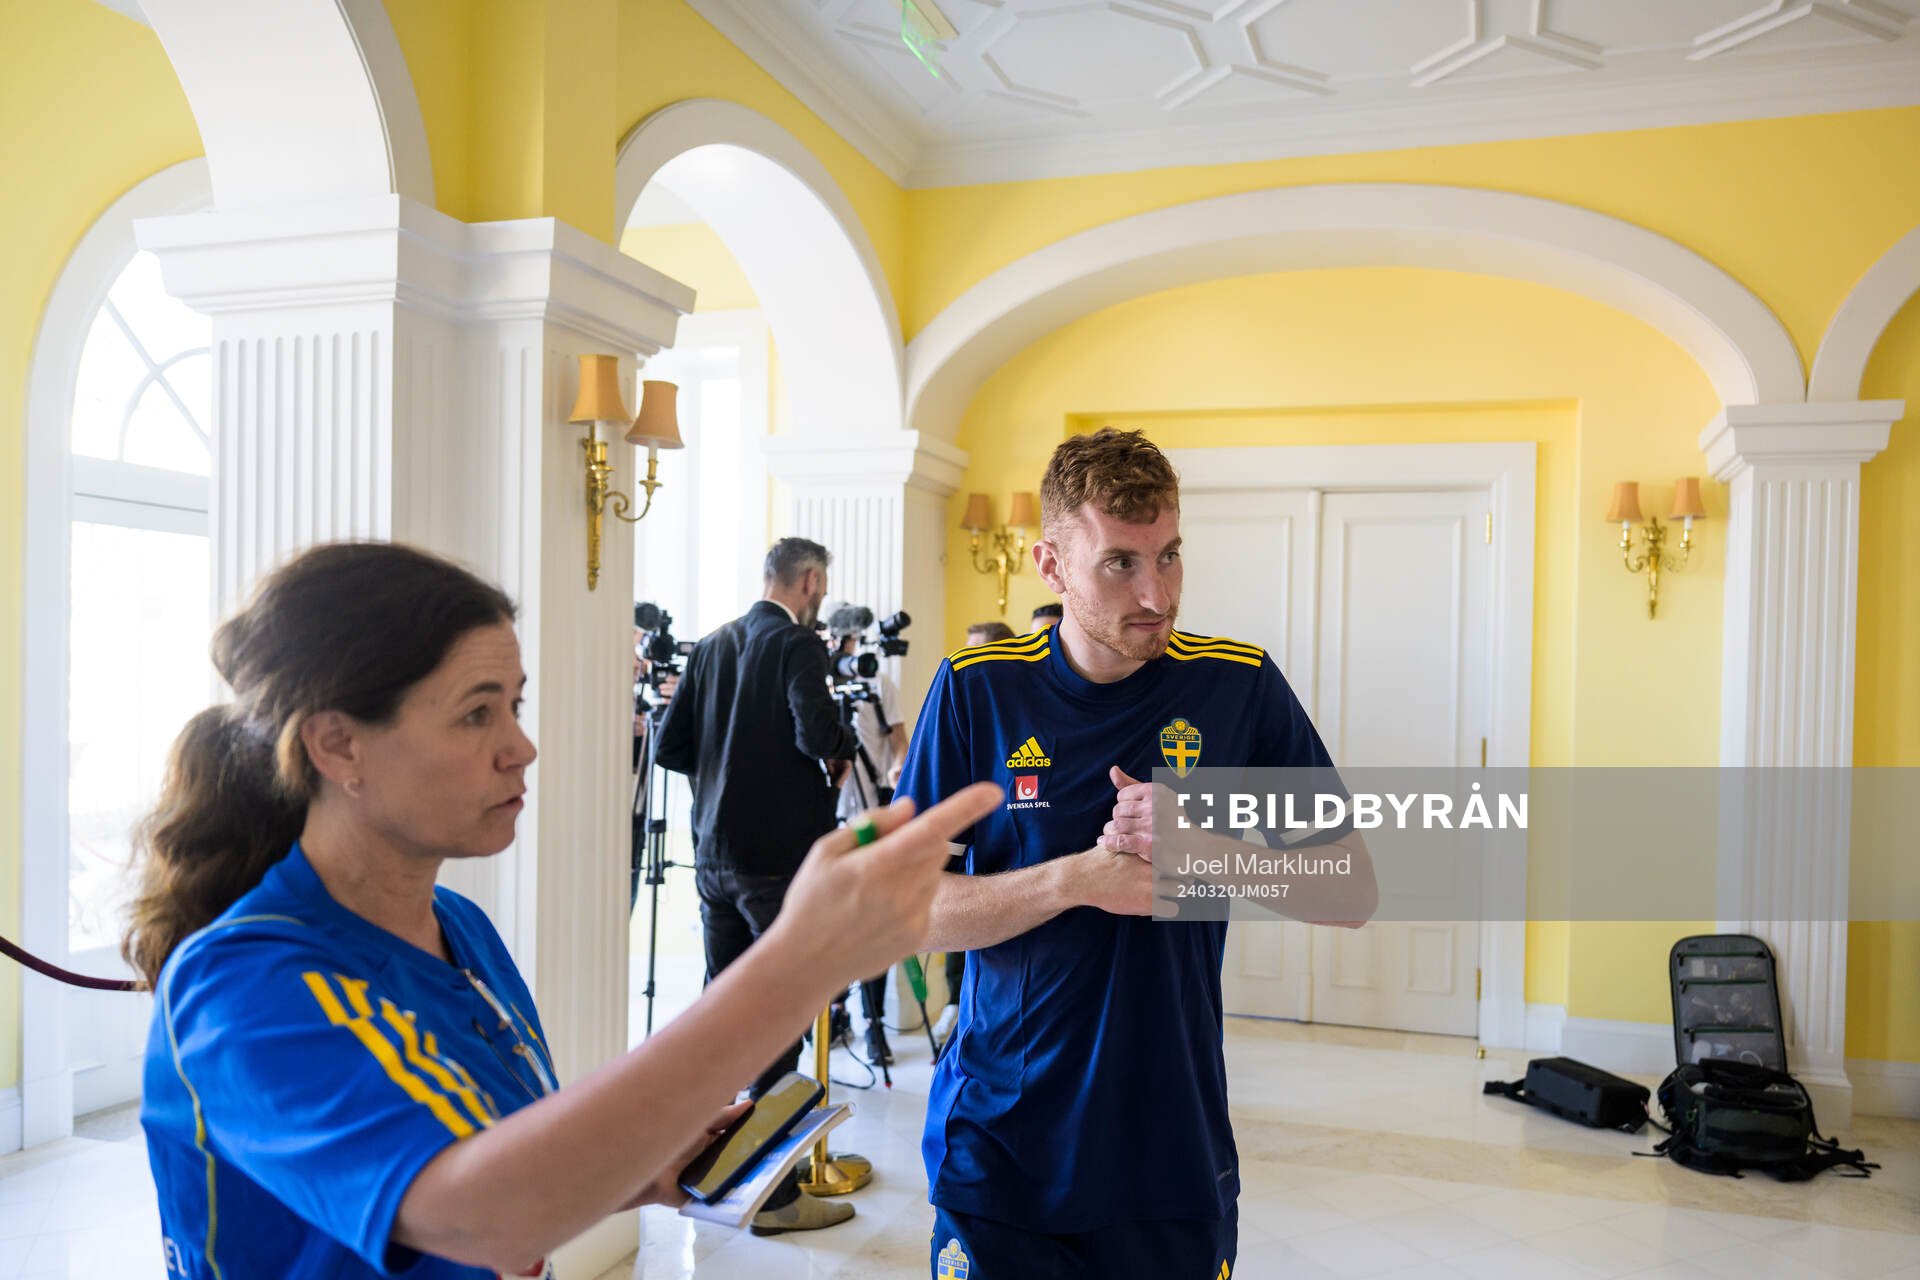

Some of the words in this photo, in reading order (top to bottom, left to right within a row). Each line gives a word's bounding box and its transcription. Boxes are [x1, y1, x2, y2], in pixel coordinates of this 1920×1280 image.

[1006, 755, 1051, 769] adidas
[1006, 802, 1034, 811] SVENSKA
[1034, 801, 1051, 809] SPEL
